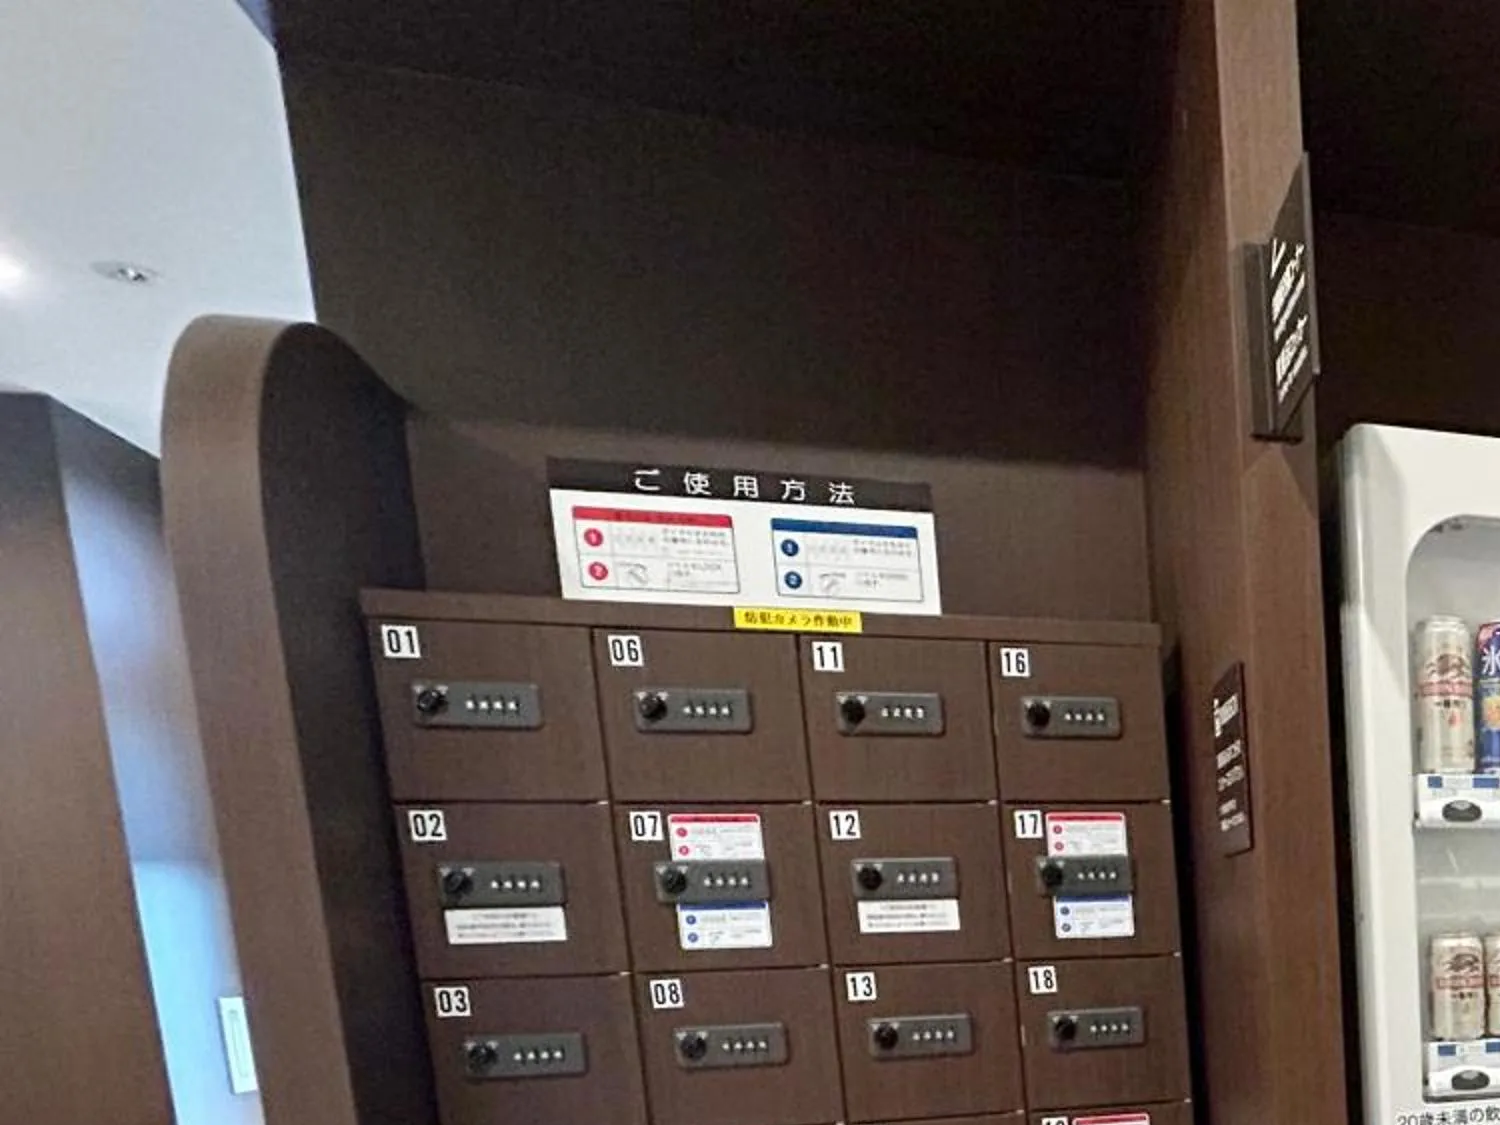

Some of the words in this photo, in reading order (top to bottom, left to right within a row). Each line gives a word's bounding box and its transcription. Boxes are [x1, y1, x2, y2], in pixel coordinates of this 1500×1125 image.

[634, 469, 855, 505] ご使用方法
[387, 629, 415, 654] 01
[611, 639, 639, 662] 06
[817, 645, 839, 668] 11
[1004, 651, 1026, 674] 16
[412, 813, 443, 837] 02
[633, 814, 658, 837] 07
[833, 814, 856, 836] 12
[1018, 813, 1038, 835] 17
[850, 975, 873, 997] 13
[1033, 969, 1054, 990] 18
[438, 989, 467, 1014] 03
[654, 982, 680, 1005] 08
